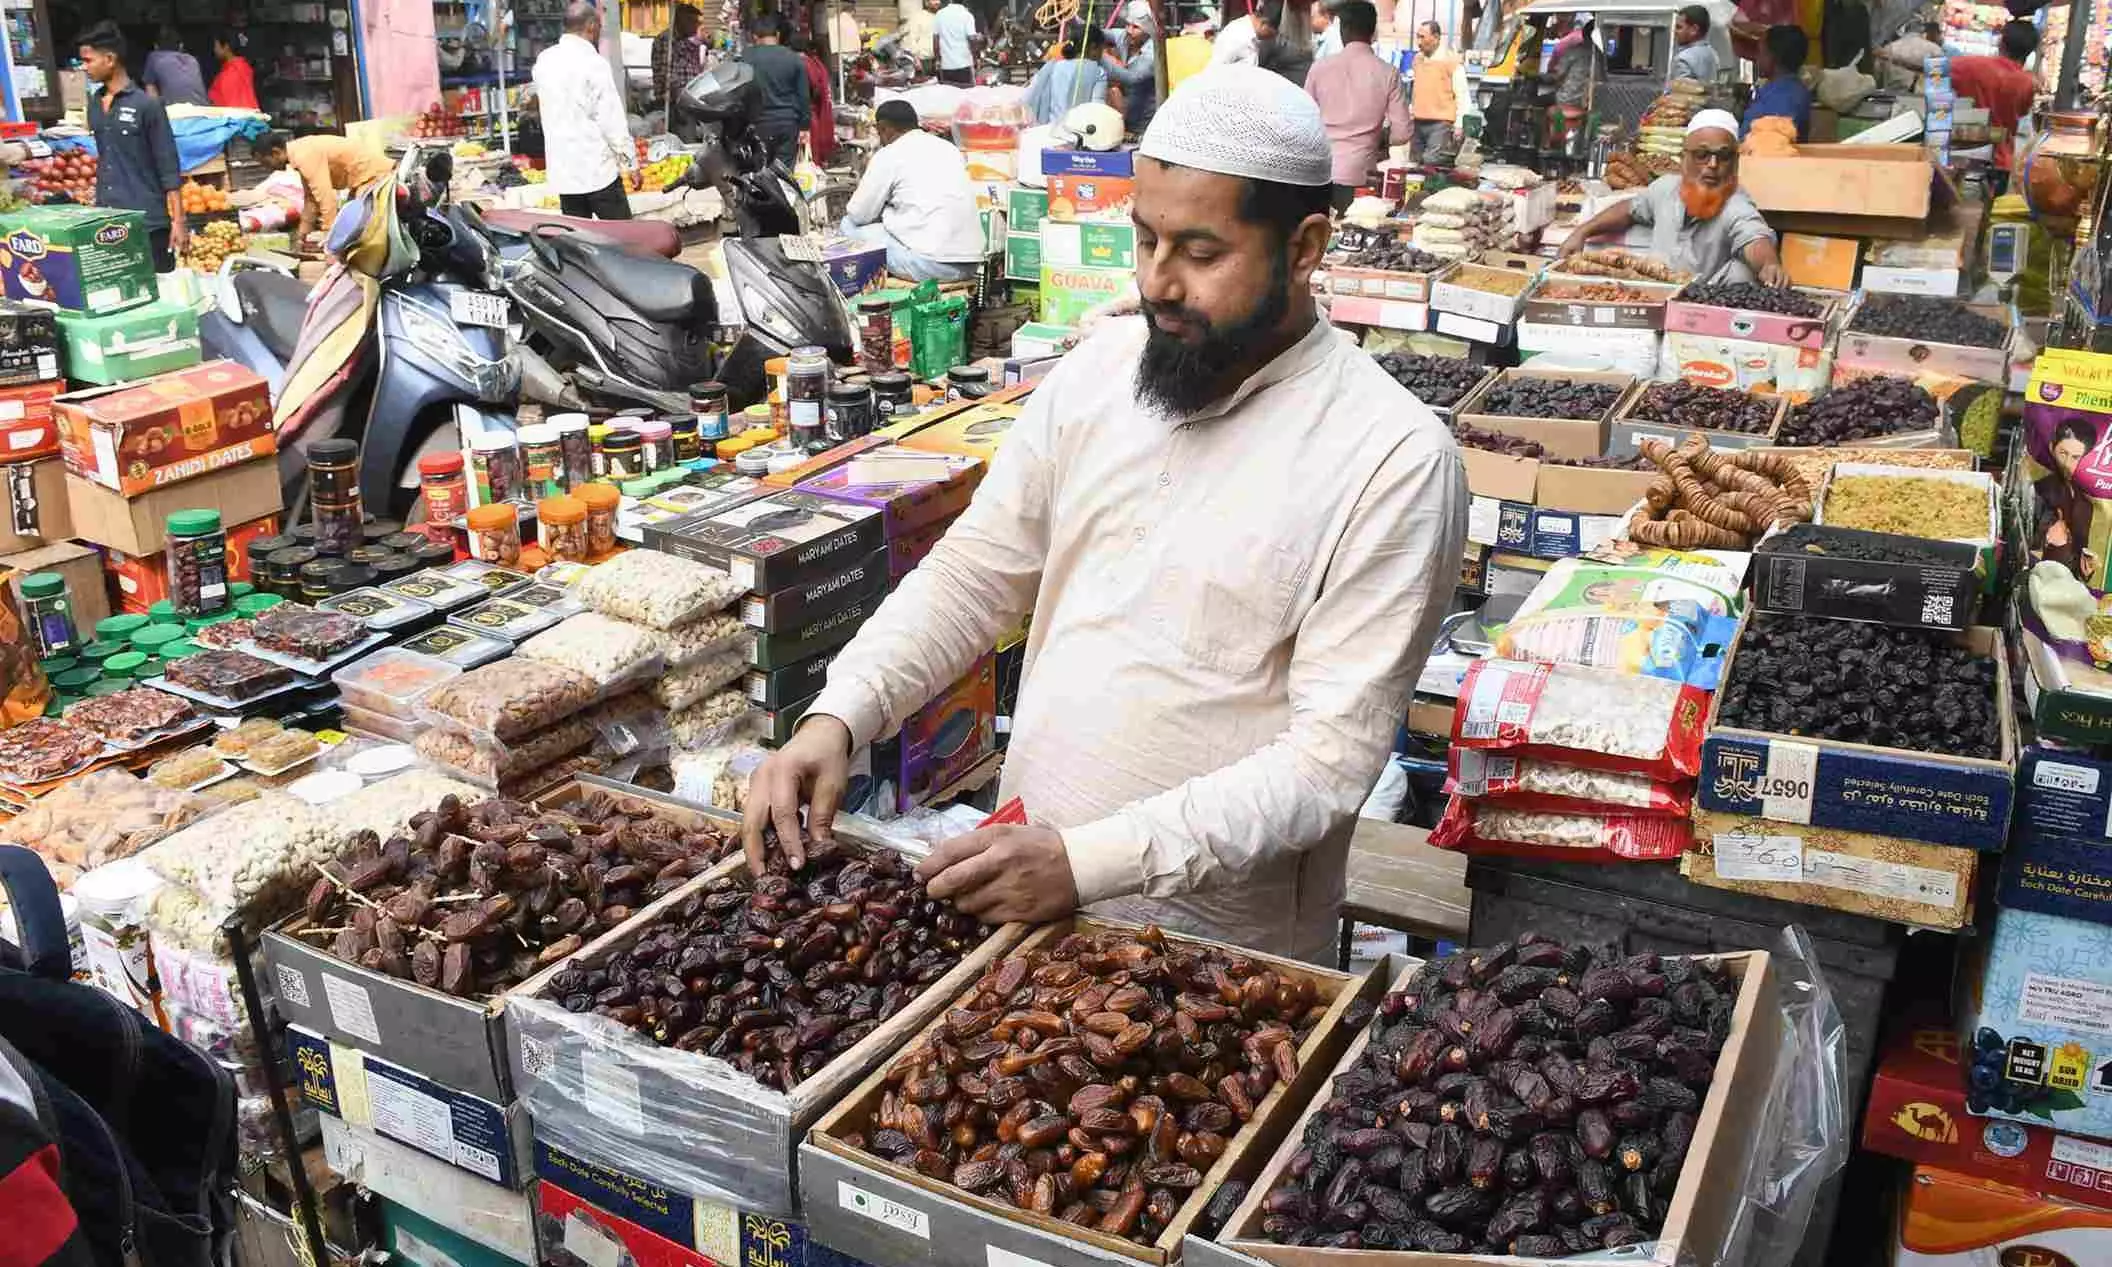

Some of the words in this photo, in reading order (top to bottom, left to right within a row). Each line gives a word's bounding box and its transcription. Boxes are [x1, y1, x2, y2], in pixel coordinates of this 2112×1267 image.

[12, 237, 41, 254] FARD
[1049, 272, 1116, 293] GUAVA
[208, 440, 253, 469] DATES
[834, 530, 858, 549] DATES
[840, 567, 864, 587] DATES
[838, 604, 862, 624] DATES
[1761, 778, 1809, 800] 0657
[1844, 777, 1886, 793] Selected
[1888, 781, 1934, 799] Carefully
[1937, 788, 1962, 802] Date
[1965, 792, 1989, 806] Each
[2020, 878, 2044, 891] Each
[2047, 881, 2072, 896] Date
[548, 1152, 568, 1168] Each
[569, 1162, 589, 1178] Date
[631, 1191, 668, 1216] Selected
